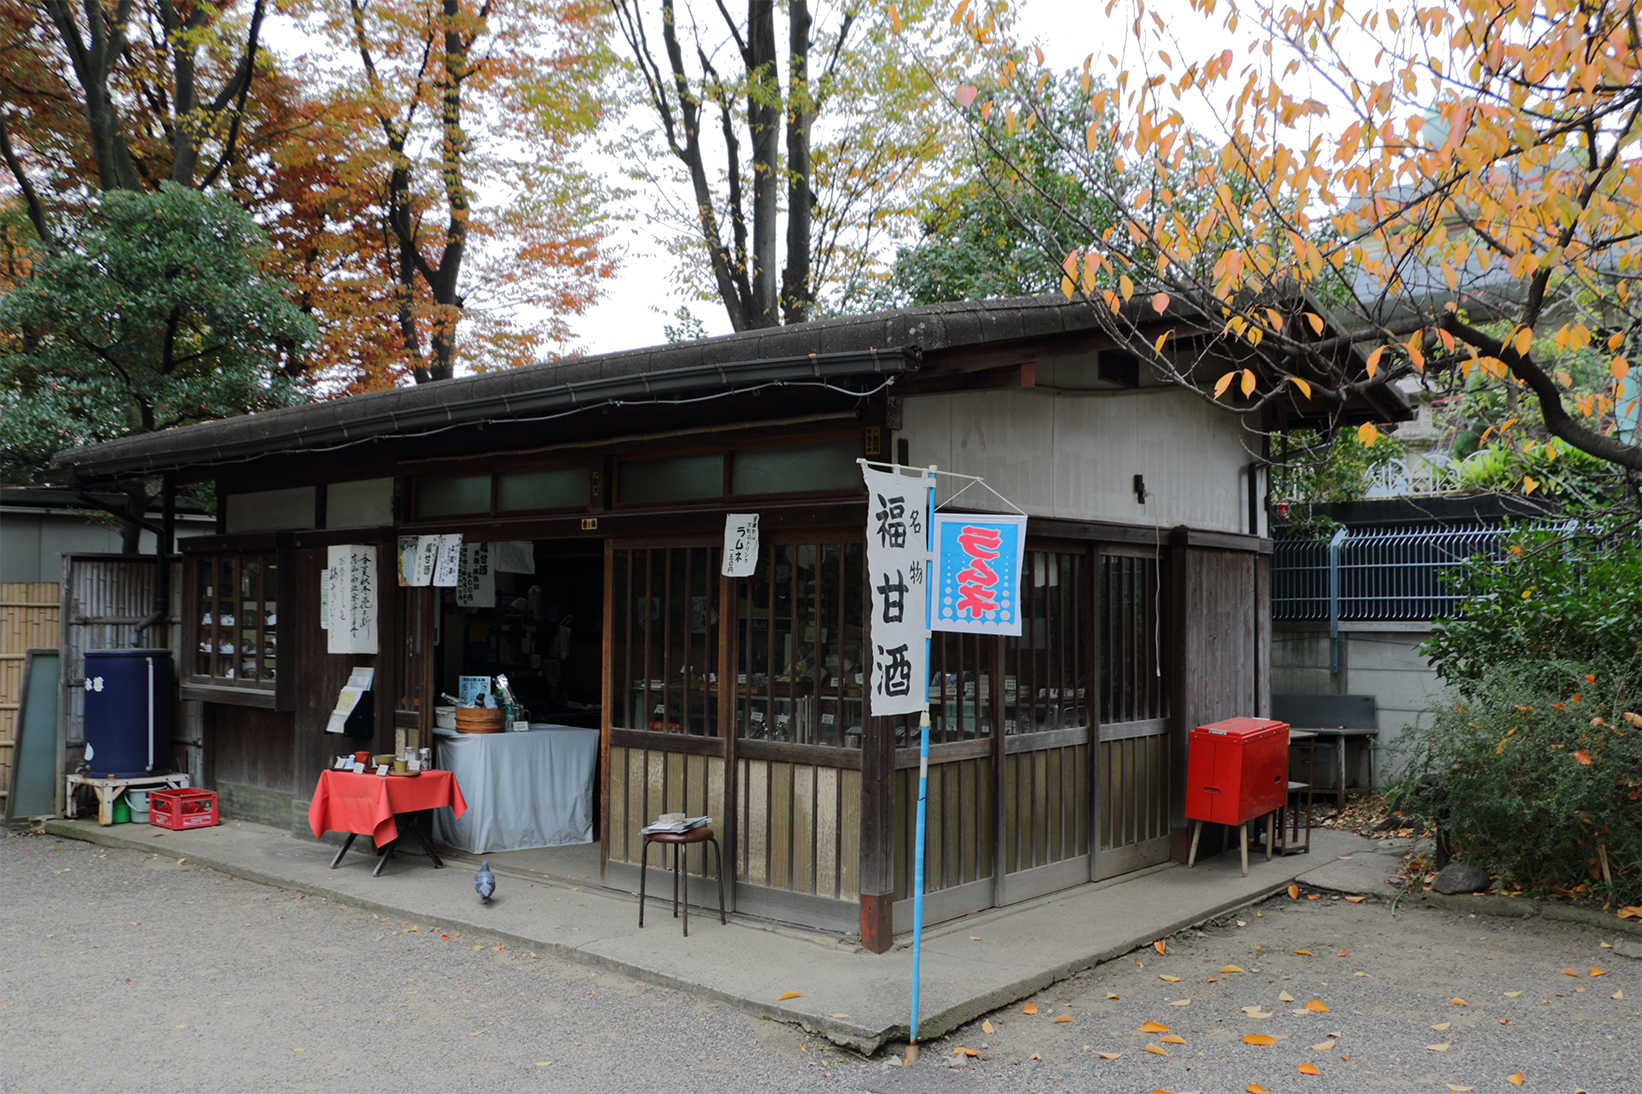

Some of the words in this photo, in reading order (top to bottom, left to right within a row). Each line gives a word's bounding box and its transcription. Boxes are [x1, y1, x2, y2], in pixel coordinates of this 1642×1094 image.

[735, 526, 746, 563] ラムネ
[909, 509, 922, 584] 名物
[956, 525, 1002, 619] ラムネ
[876, 493, 912, 697] 福甘酒
